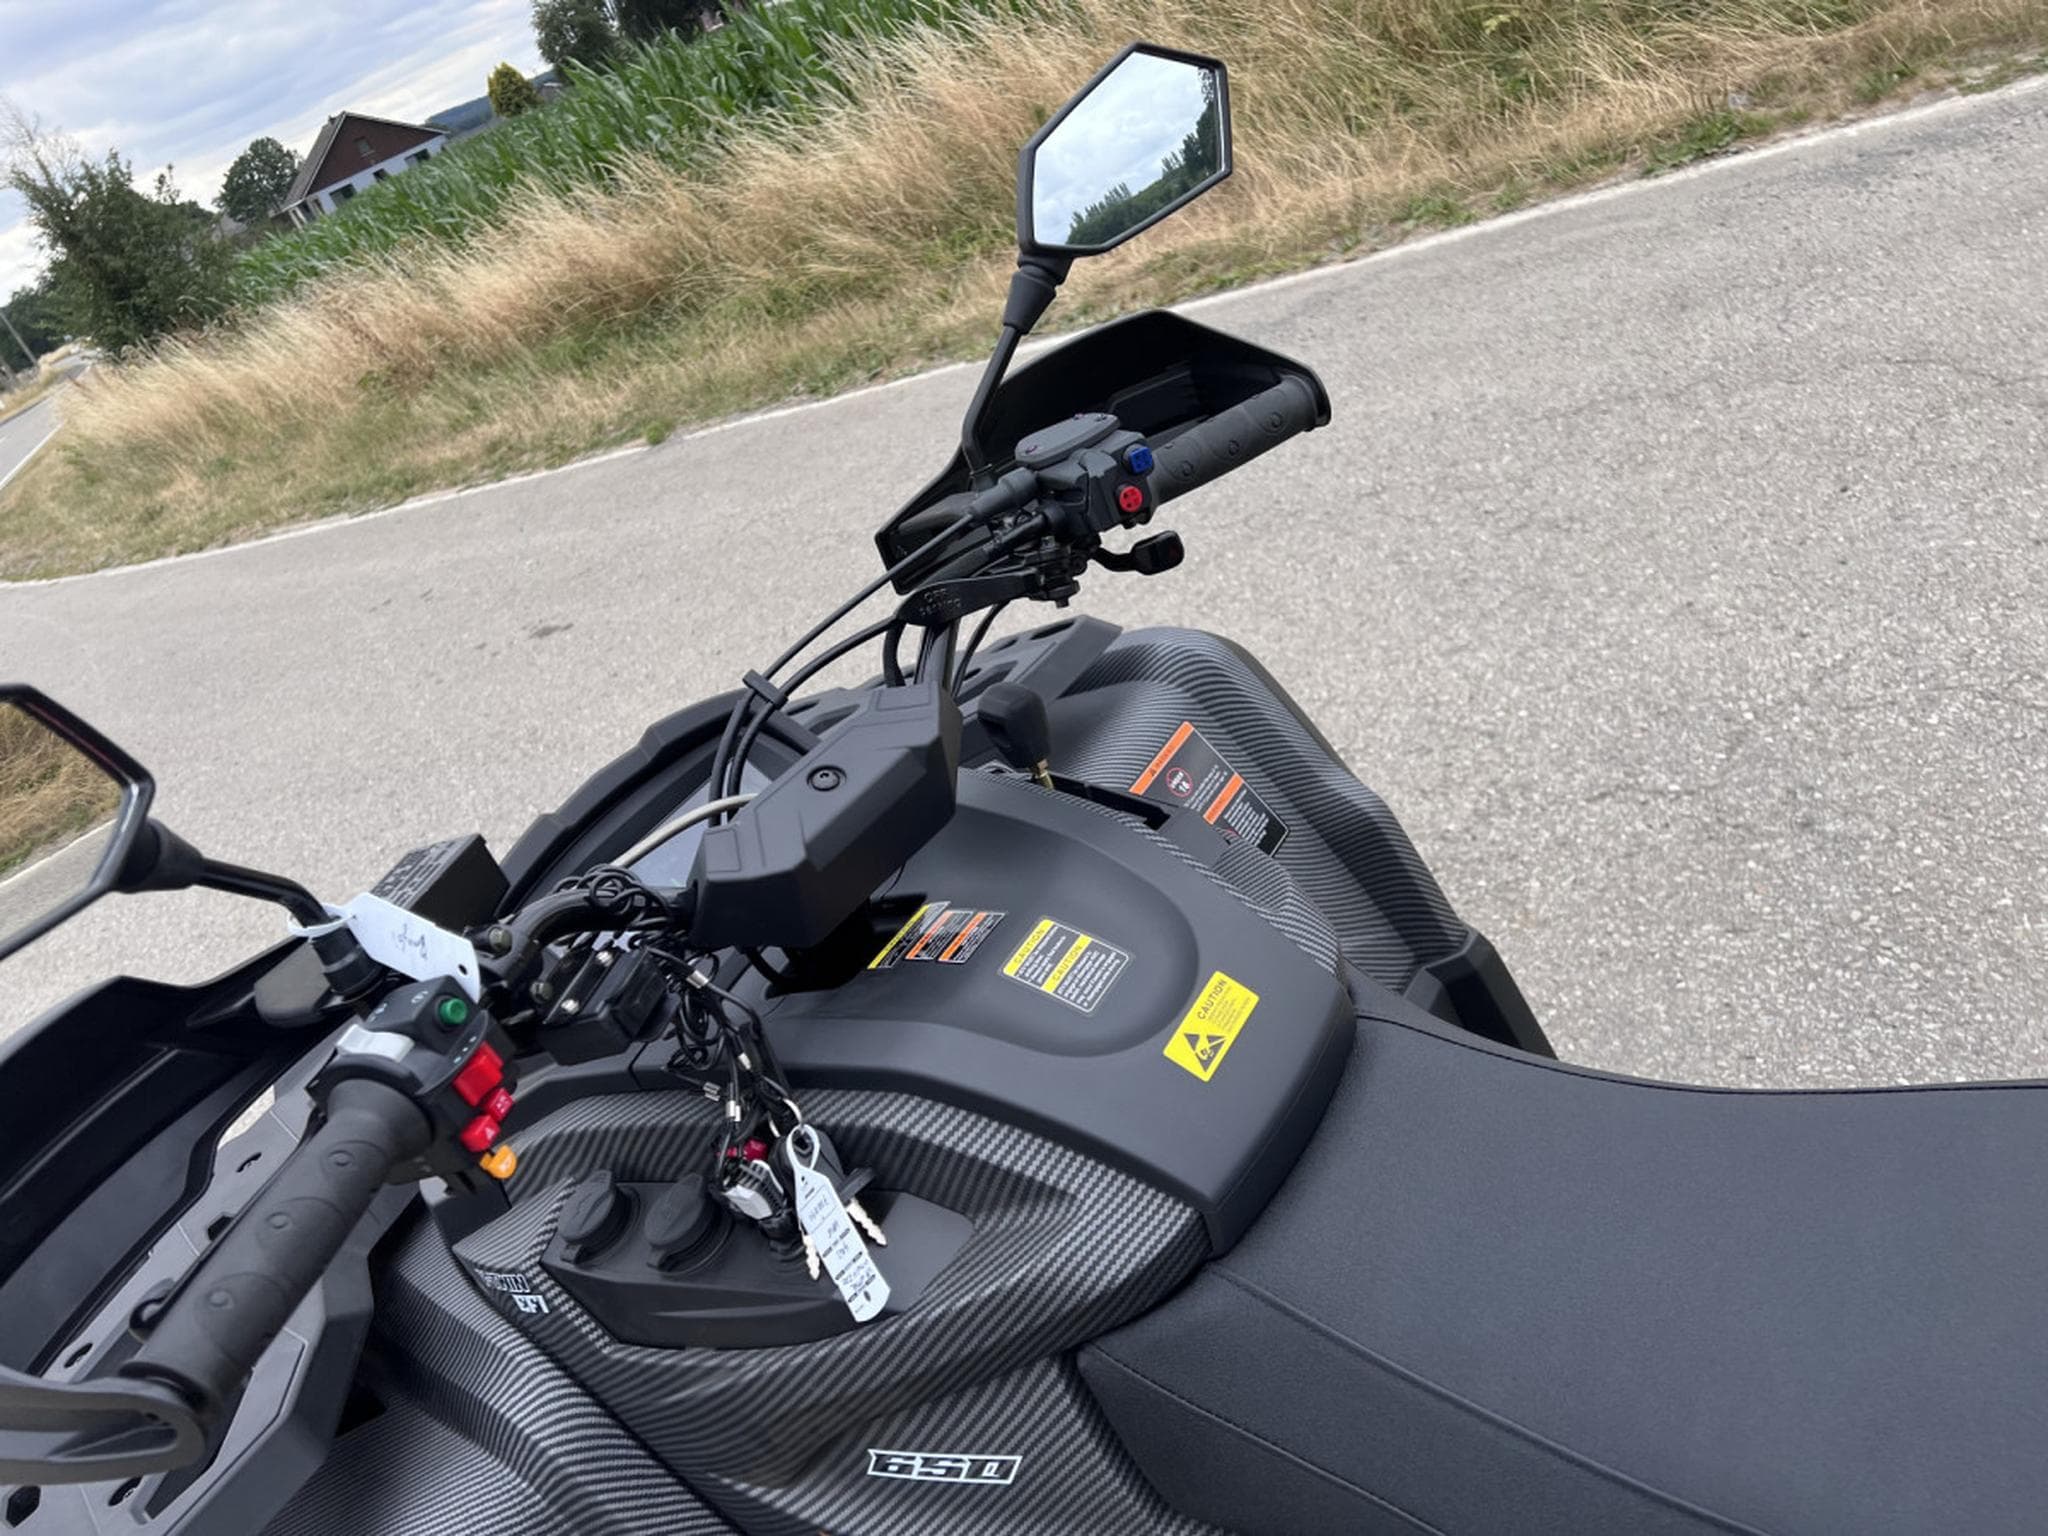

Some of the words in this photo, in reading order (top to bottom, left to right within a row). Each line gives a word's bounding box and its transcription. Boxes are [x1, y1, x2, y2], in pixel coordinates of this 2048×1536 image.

[1014, 929, 1045, 963] CAUTION
[1052, 945, 1082, 980] CAUTION
[1197, 979, 1227, 1020] CAUTION
[512, 1294, 550, 1313] EFI
